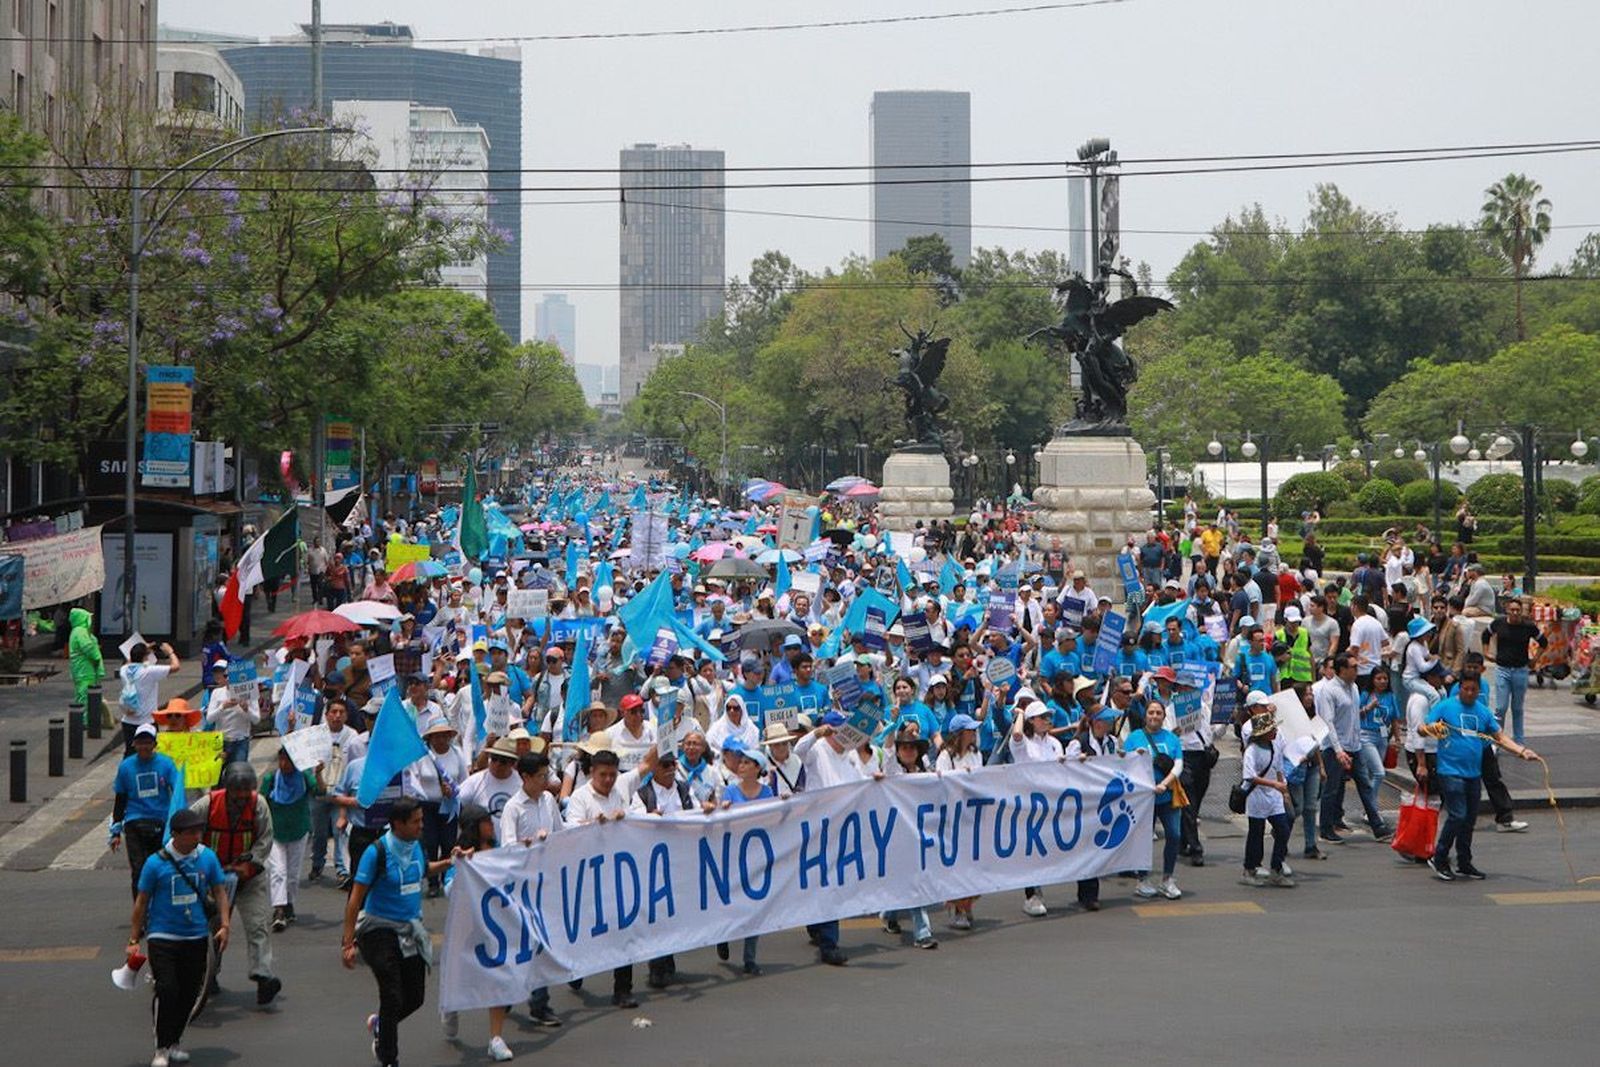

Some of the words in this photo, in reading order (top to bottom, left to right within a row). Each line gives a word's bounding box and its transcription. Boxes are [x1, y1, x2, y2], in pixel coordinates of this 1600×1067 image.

[474, 872, 552, 968] SIN
[561, 842, 675, 944] VIDA
[698, 828, 774, 911] NO
[799, 807, 898, 890] HAY
[917, 788, 1083, 871] FUTURO
